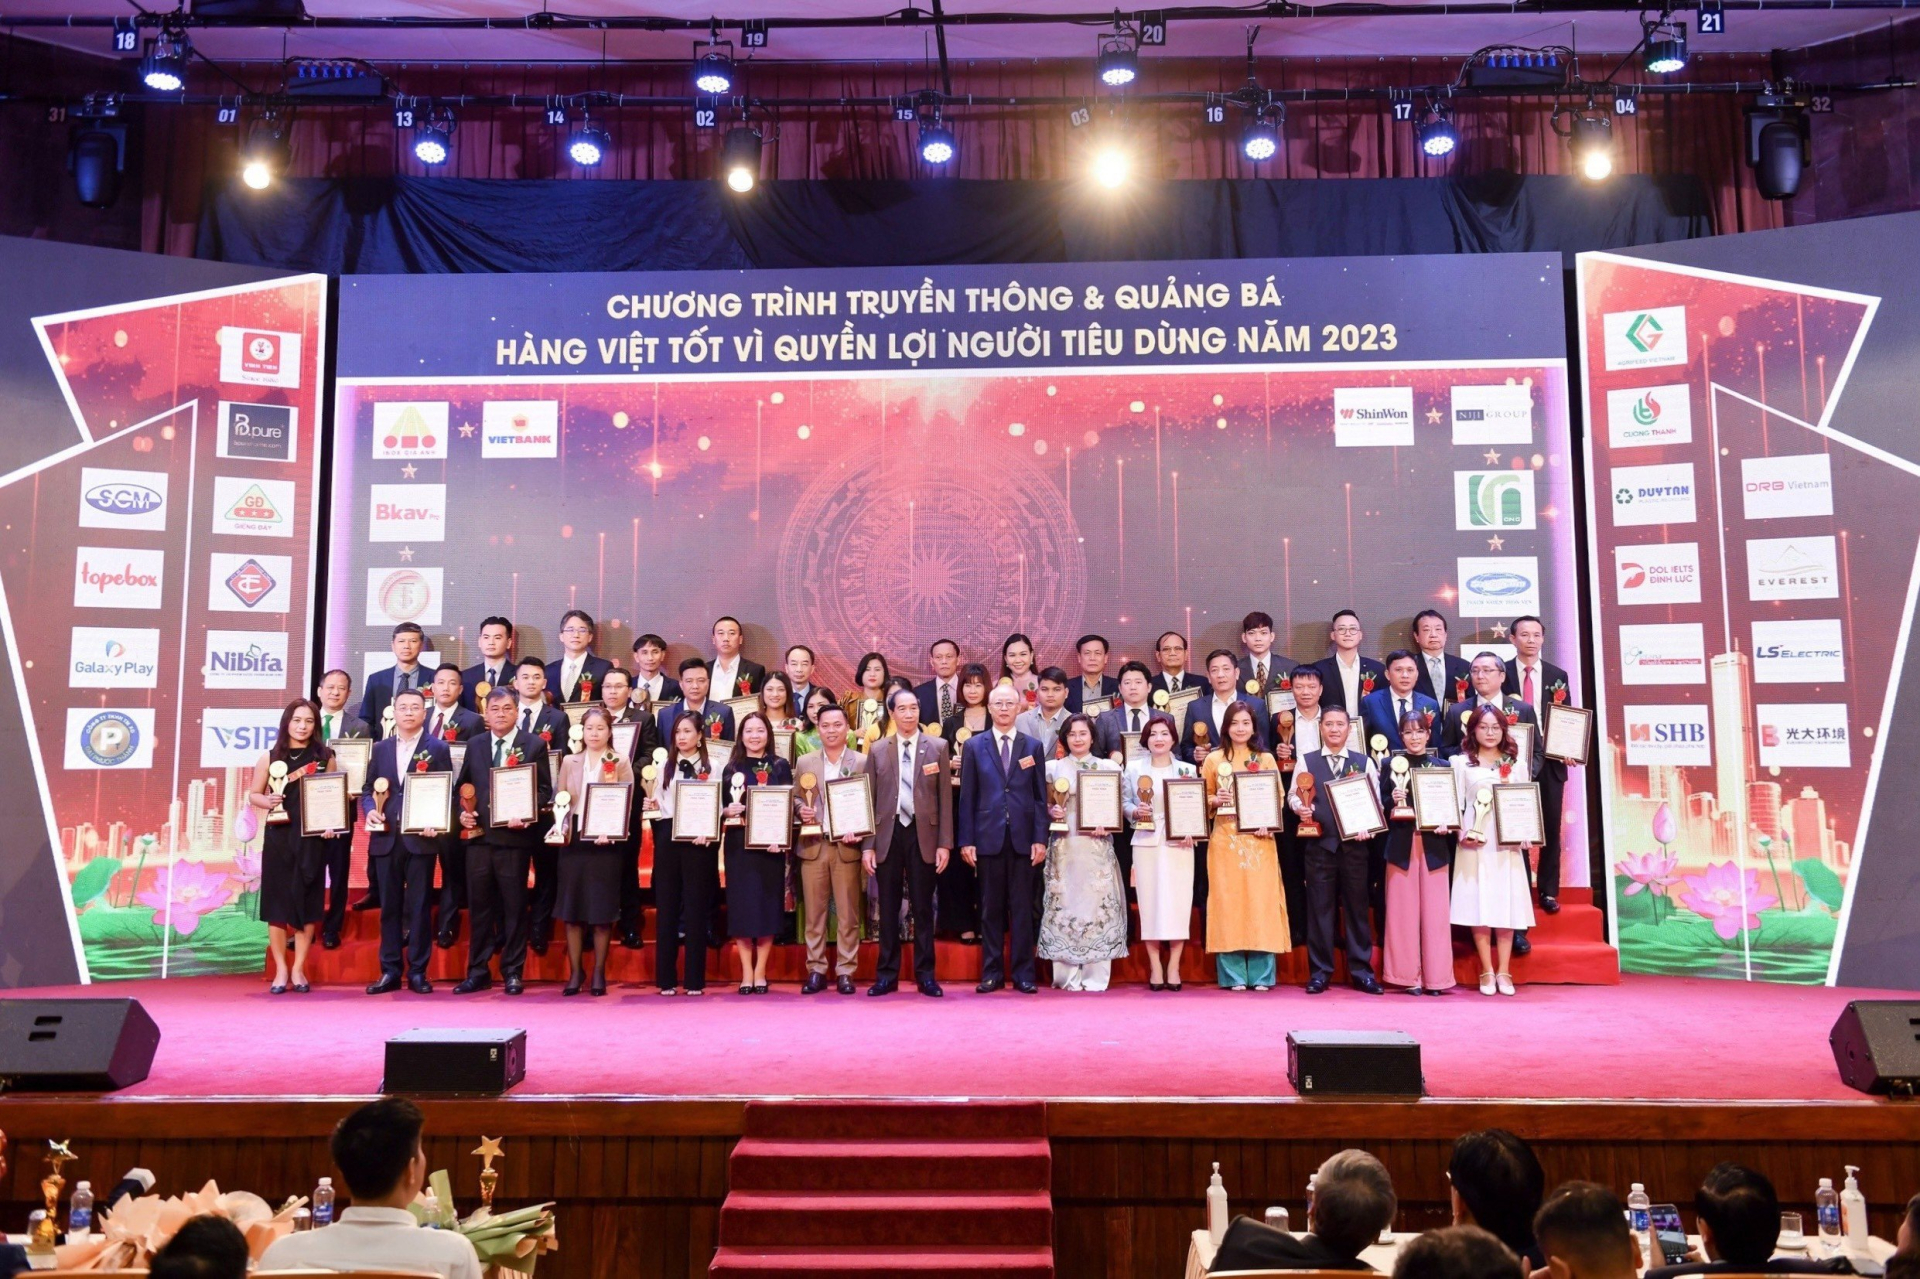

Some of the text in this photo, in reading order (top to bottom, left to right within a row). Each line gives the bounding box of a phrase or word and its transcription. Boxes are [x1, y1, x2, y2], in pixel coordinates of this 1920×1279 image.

[1701, 14, 1721, 31] 21
[117, 33, 135, 49] 18
[746, 32, 763, 46] 19
[1143, 25, 1163, 43] 20
[1394, 104, 1412, 119] 17
[1615, 99, 1635, 115] 04
[1812, 97, 1831, 111] 32
[48, 107, 66, 122] 31
[218, 107, 236, 123] 01
[396, 111, 413, 127] 13
[547, 109, 564, 124] 14
[696, 110, 714, 127] 02
[896, 109, 913, 121] 15
[1071, 108, 1090, 125] 03
[1207, 107, 1224, 123] 16
[607, 275, 1281, 319] CHƯƠNG TRÌNH TRUYỀN THÔNG & QUẢNG BÁ
[496, 319, 1398, 371] HÀNG VIỆT TỐT VÌ QUYỀN LỢI NGƯỜI TIÊU DÙNG NĂM 2023
[1356, 409, 1408, 419] ShinWon
[488, 435, 551, 444] VIETBANK
[1746, 480, 1829, 492] DRB Vietnam
[376, 503, 428, 520] Bkav
[1649, 565, 1694, 574] DOL IELTS
[81, 562, 157, 594] topebox
[1758, 576, 1828, 586] EVEREST
[1756, 646, 1841, 658] LS ELECTRIC
[75, 661, 154, 676] Galaxy Play
[210, 652, 283, 672] Nibifa
[1655, 723, 1705, 742] SHB
[1786, 727, 1846, 740] 光大环境
